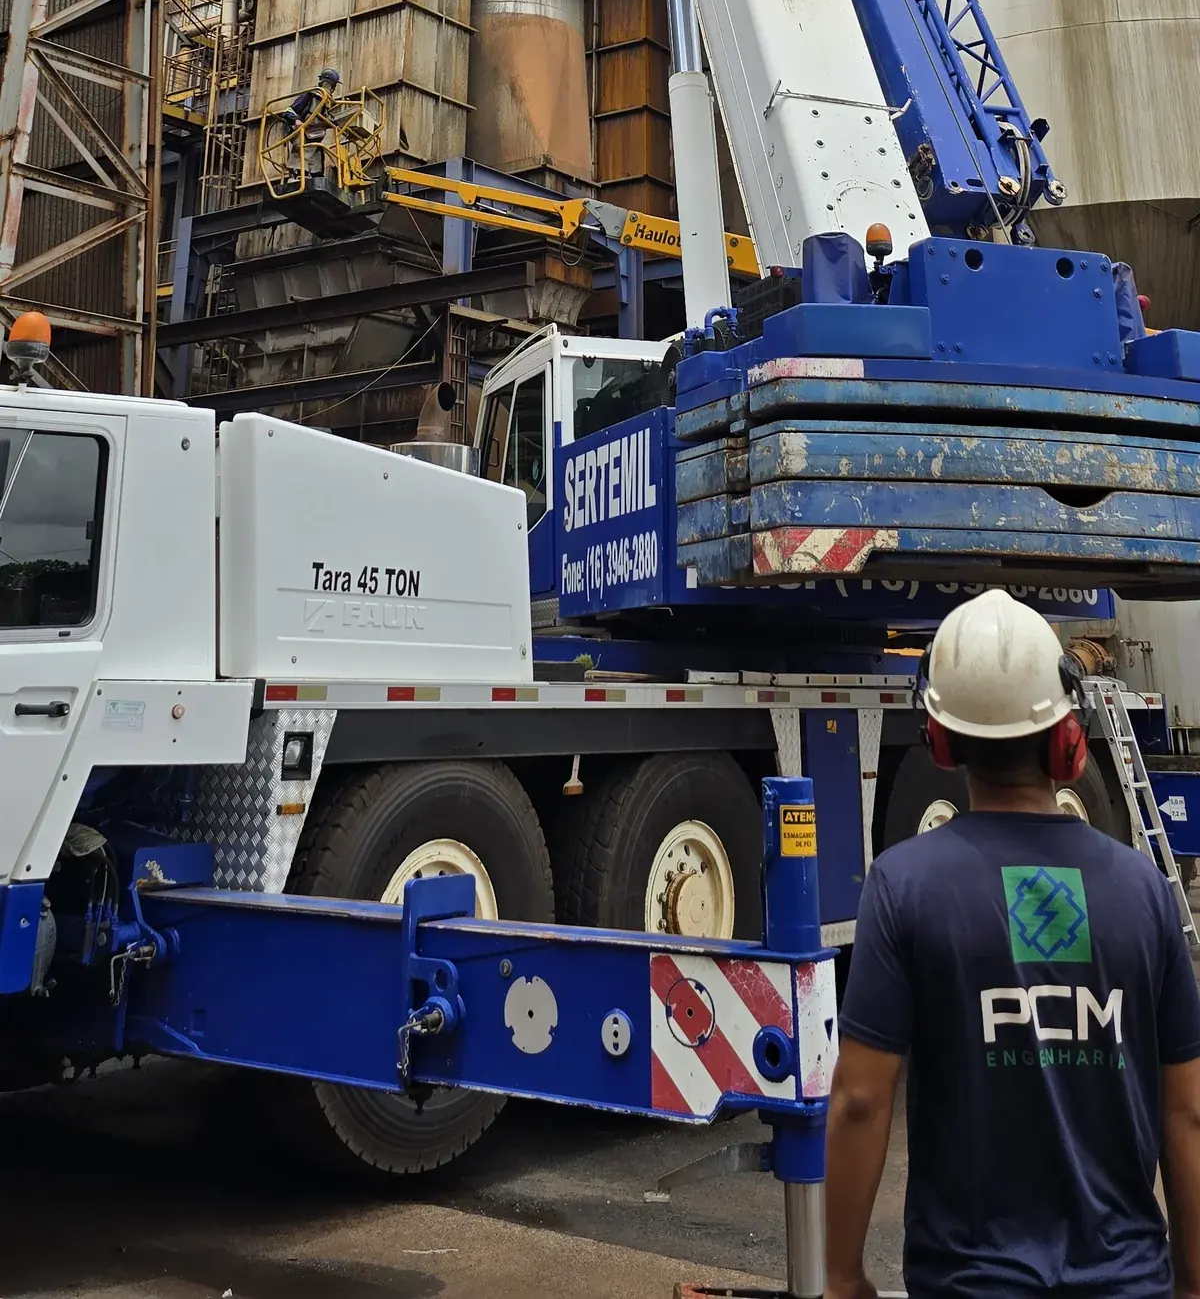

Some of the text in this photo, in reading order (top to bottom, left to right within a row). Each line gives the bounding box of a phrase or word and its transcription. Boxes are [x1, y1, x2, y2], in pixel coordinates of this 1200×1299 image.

[564, 428, 656, 533] SERTEMIL
[312, 562, 420, 597] Tara 45 TON
[561, 553, 584, 595] Fone:
[586, 543, 604, 602] (16)
[606, 530, 658, 586] 3946-2880
[980, 984, 1124, 1044] PCM
[986, 1047, 1126, 1070] ENGENHARIA
